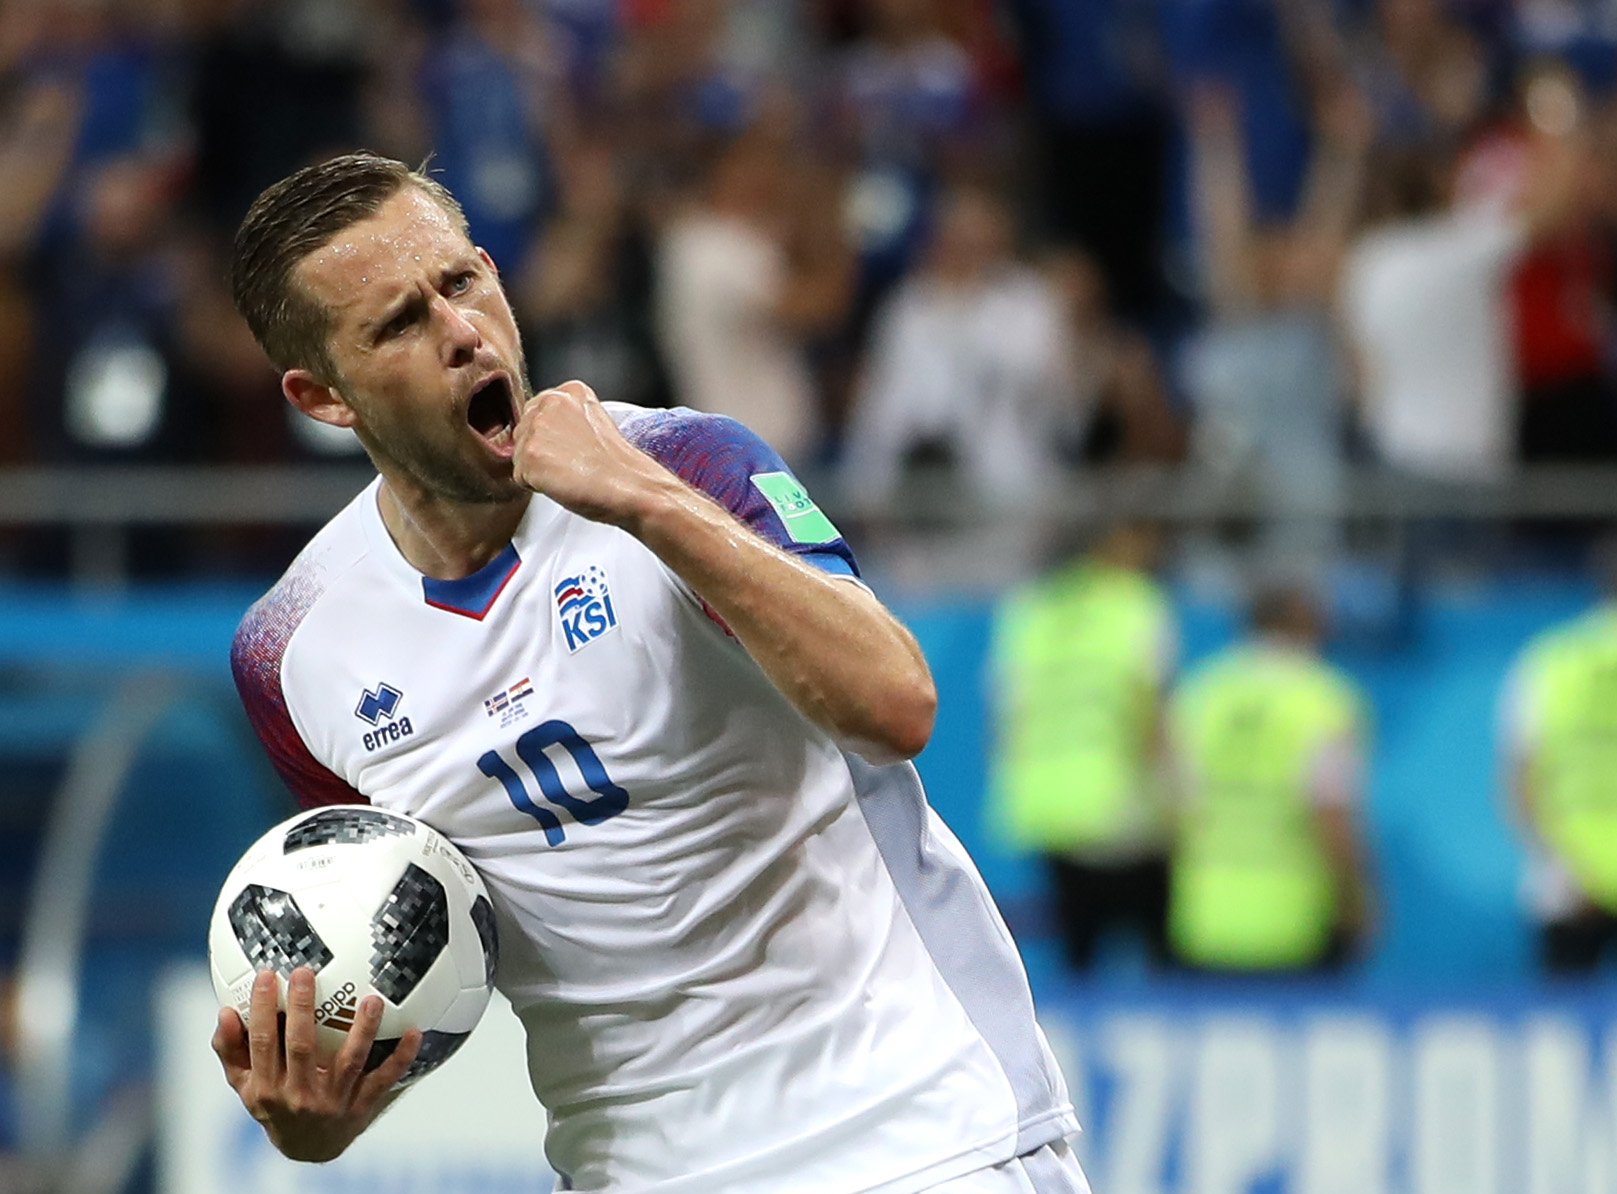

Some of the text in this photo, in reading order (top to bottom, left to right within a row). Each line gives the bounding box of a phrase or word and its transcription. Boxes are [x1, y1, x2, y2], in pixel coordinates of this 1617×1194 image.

[362, 716, 414, 752] errea
[476, 719, 630, 847] 10
[314, 982, 355, 1020] adida
